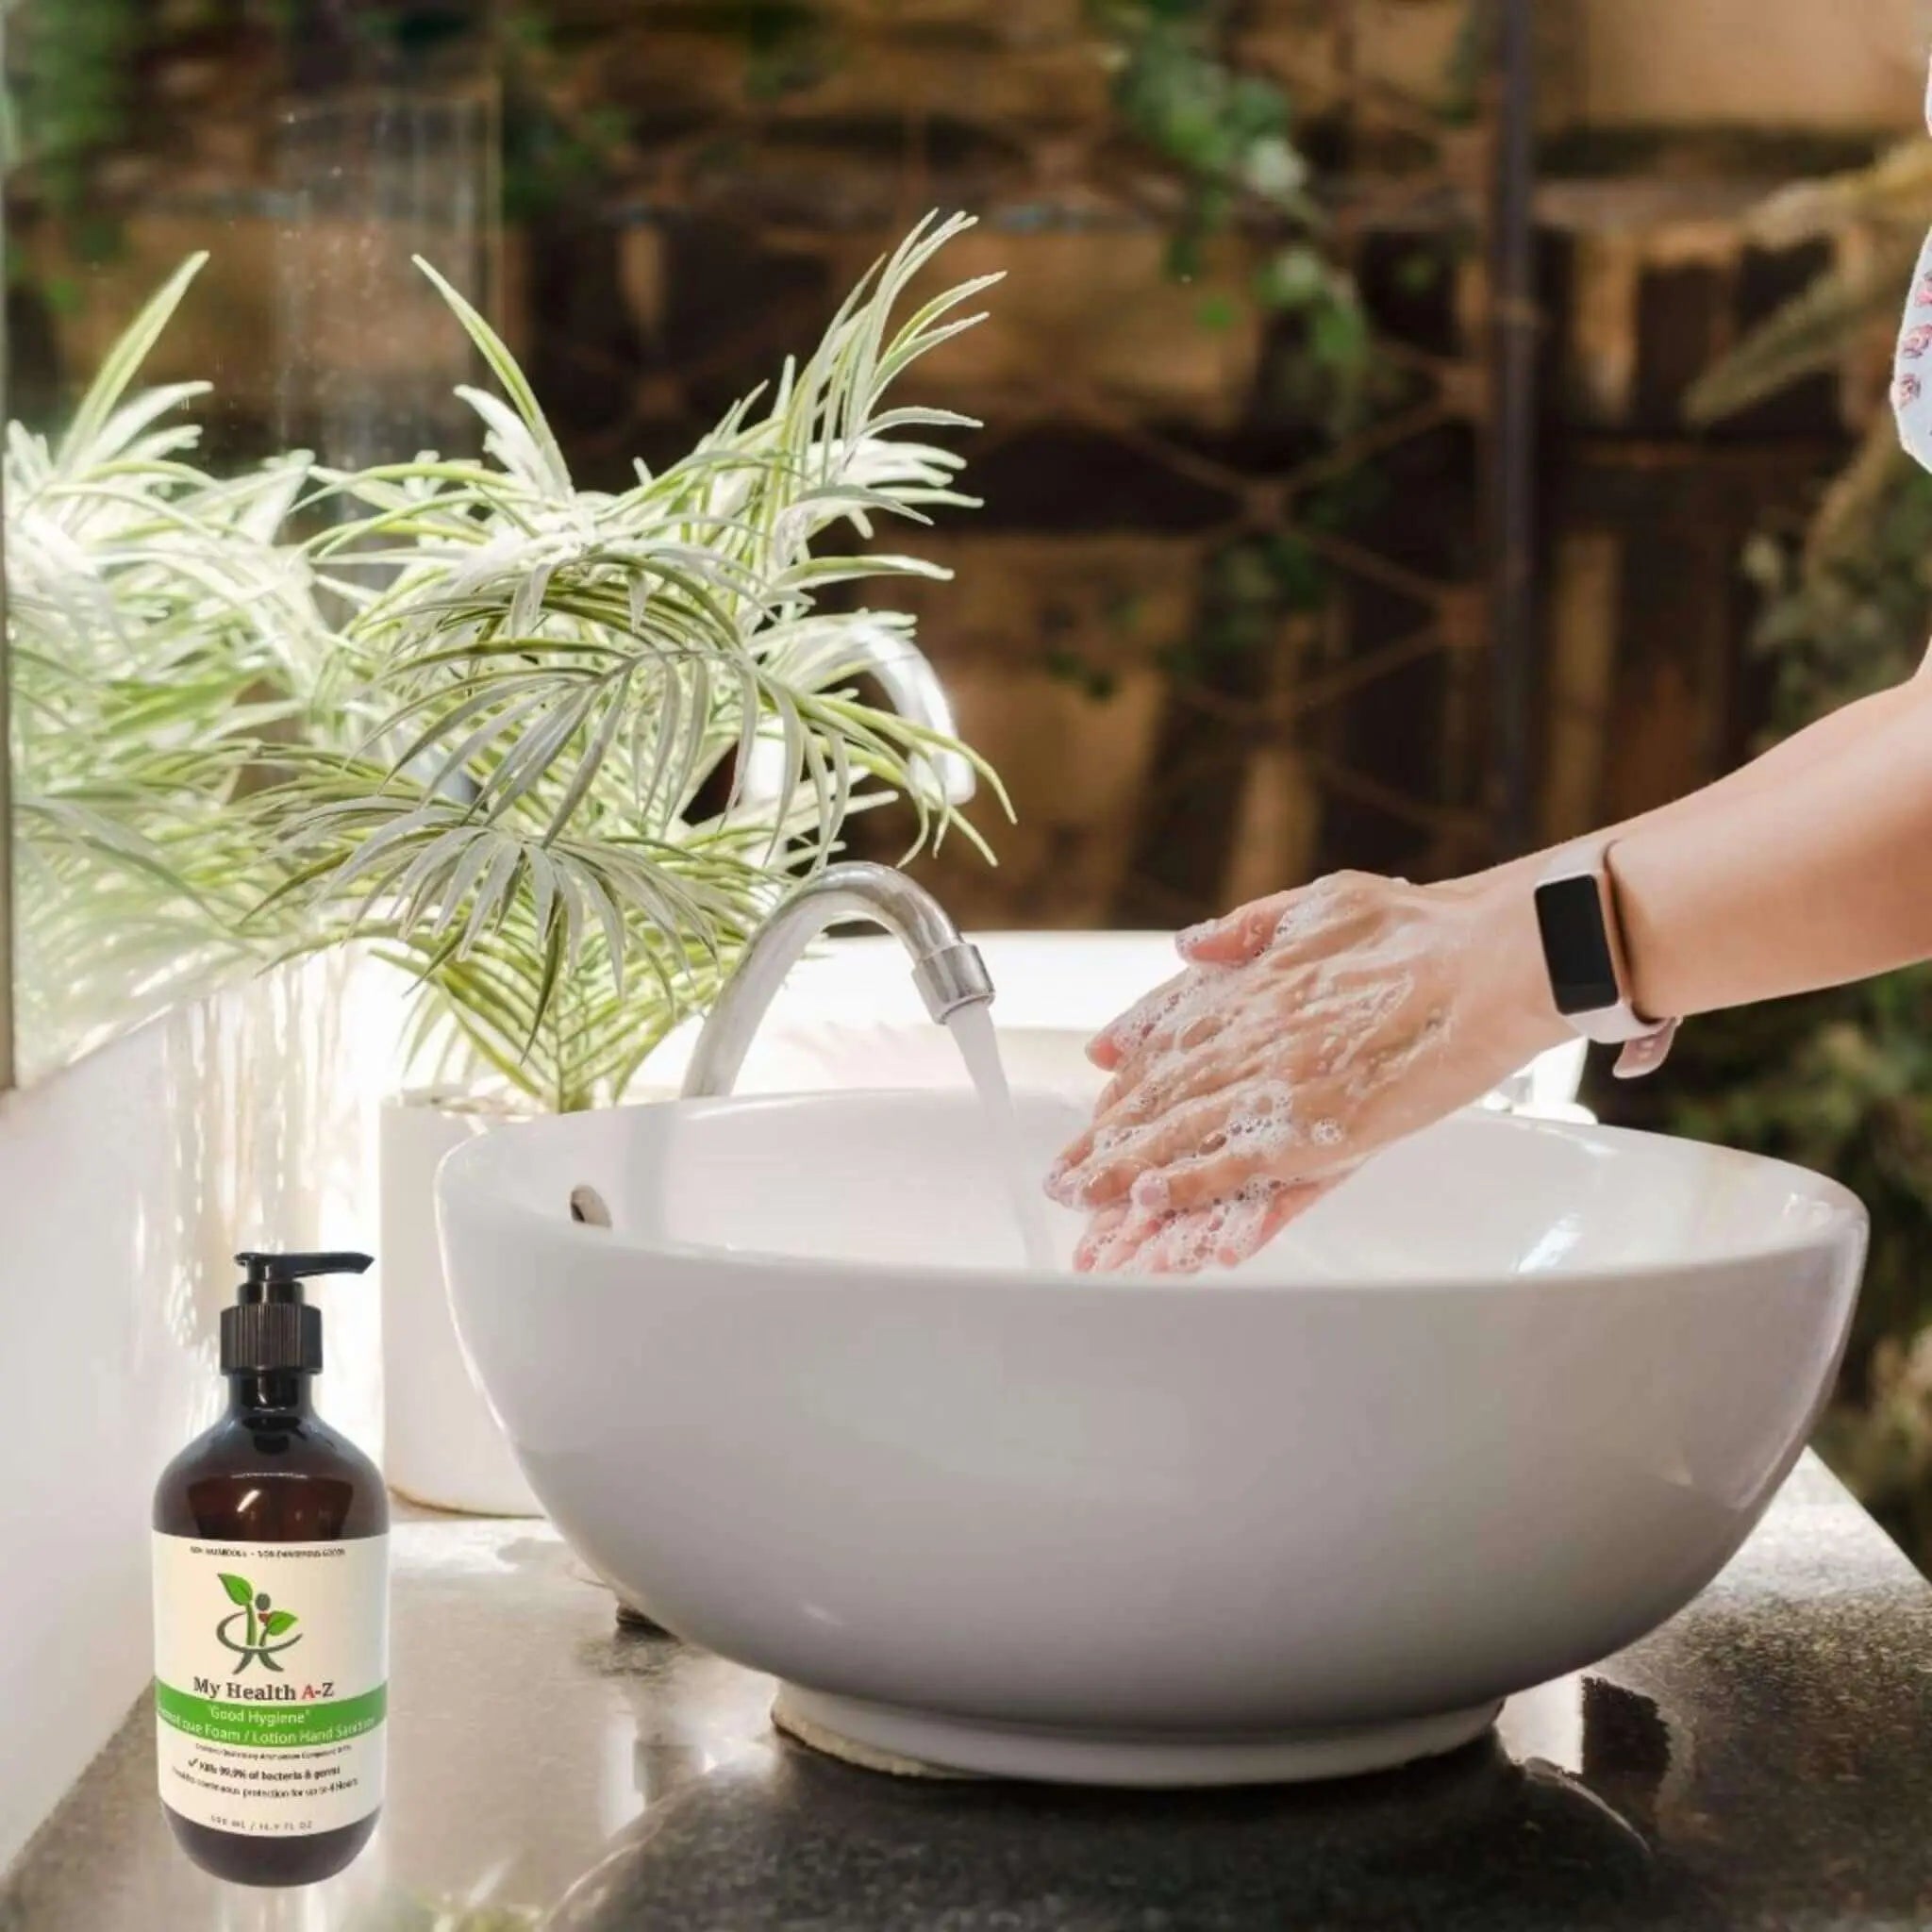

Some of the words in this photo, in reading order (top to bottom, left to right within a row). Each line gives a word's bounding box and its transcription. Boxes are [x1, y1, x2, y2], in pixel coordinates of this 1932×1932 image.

[193, 1676, 221, 1699] My
[226, 1682, 296, 1700] Health
[302, 1682, 334, 1699] A-Z
[205, 1723, 241, 1742] Foam
[252, 1730, 296, 1744] Lotion
[300, 1727, 333, 1743] Hand
[249, 1771, 259, 1780] of
[261, 1771, 302, 1781] bacteria
